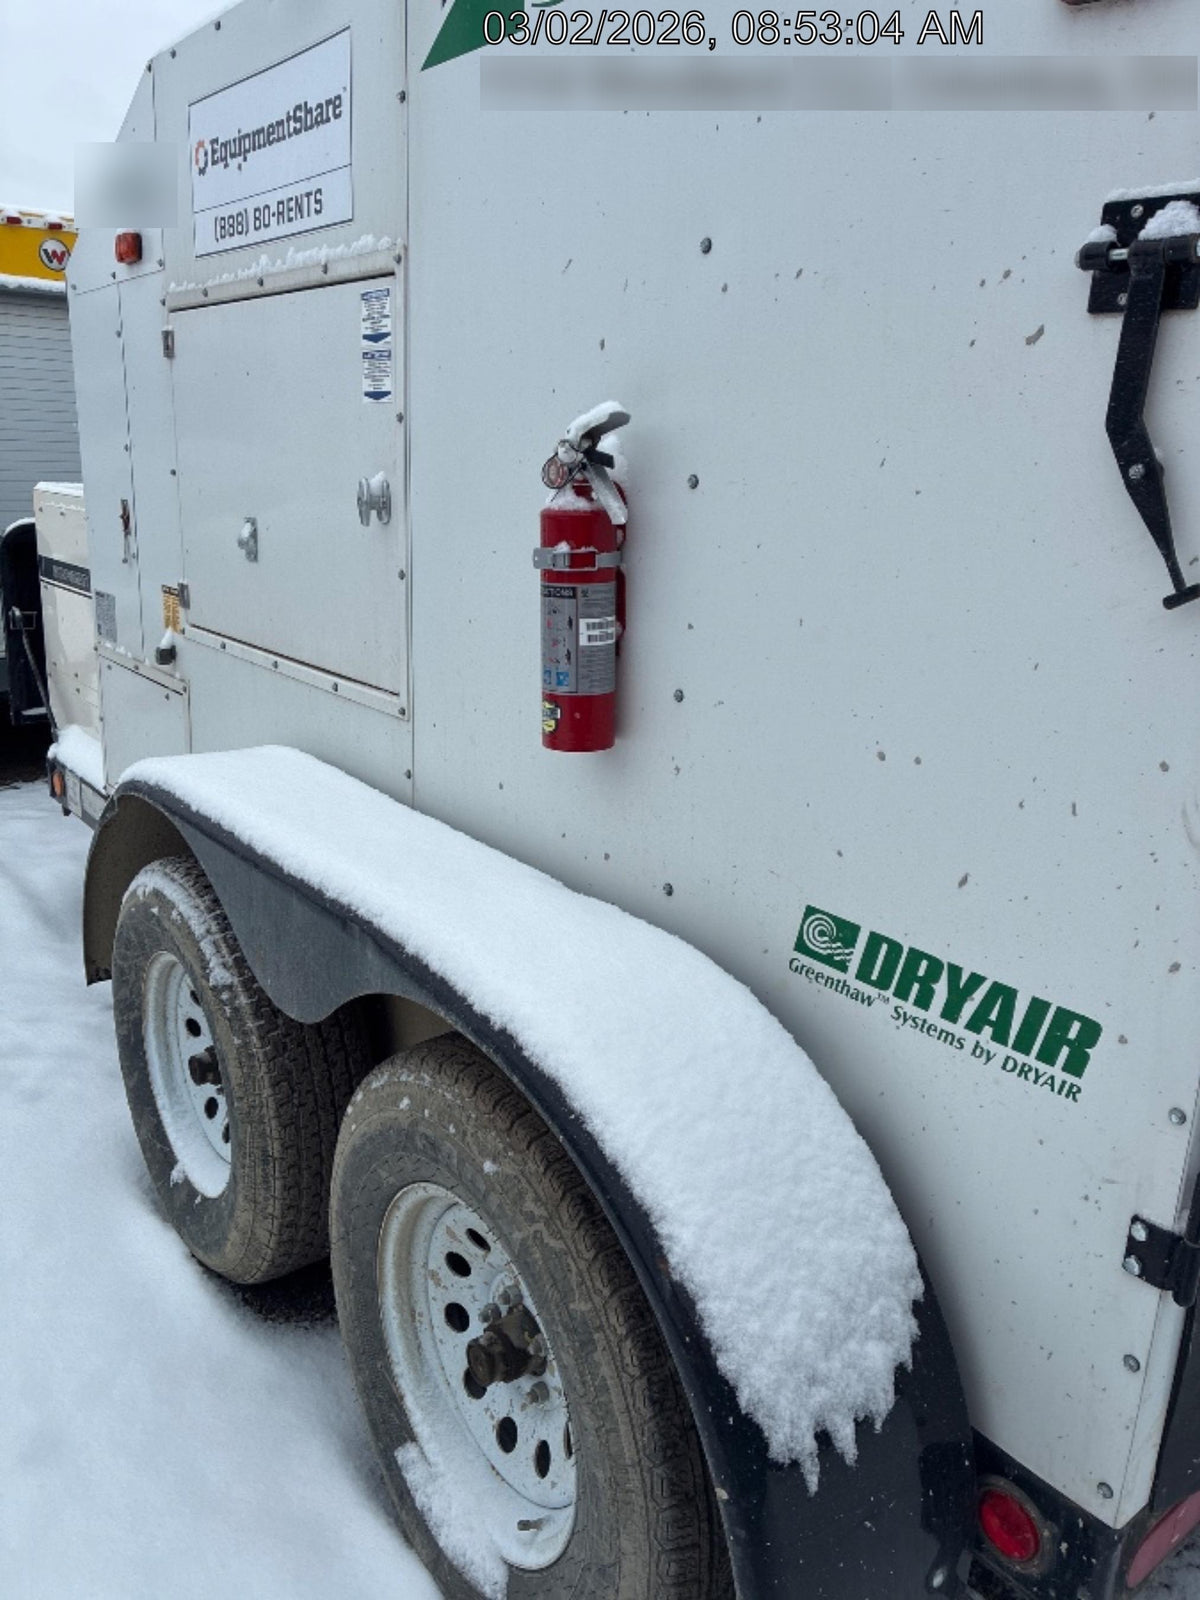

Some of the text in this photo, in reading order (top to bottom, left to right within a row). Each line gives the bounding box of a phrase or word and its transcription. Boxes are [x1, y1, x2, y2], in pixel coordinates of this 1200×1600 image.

[209, 93, 343, 169] EquipmentShare
[214, 208, 249, 242] (888)
[855, 930, 1103, 1079] DRYAIR
[890, 1005, 965, 1050] Systems
[970, 1040, 997, 1066] by
[1001, 1055, 1083, 1103] DRYAIR
